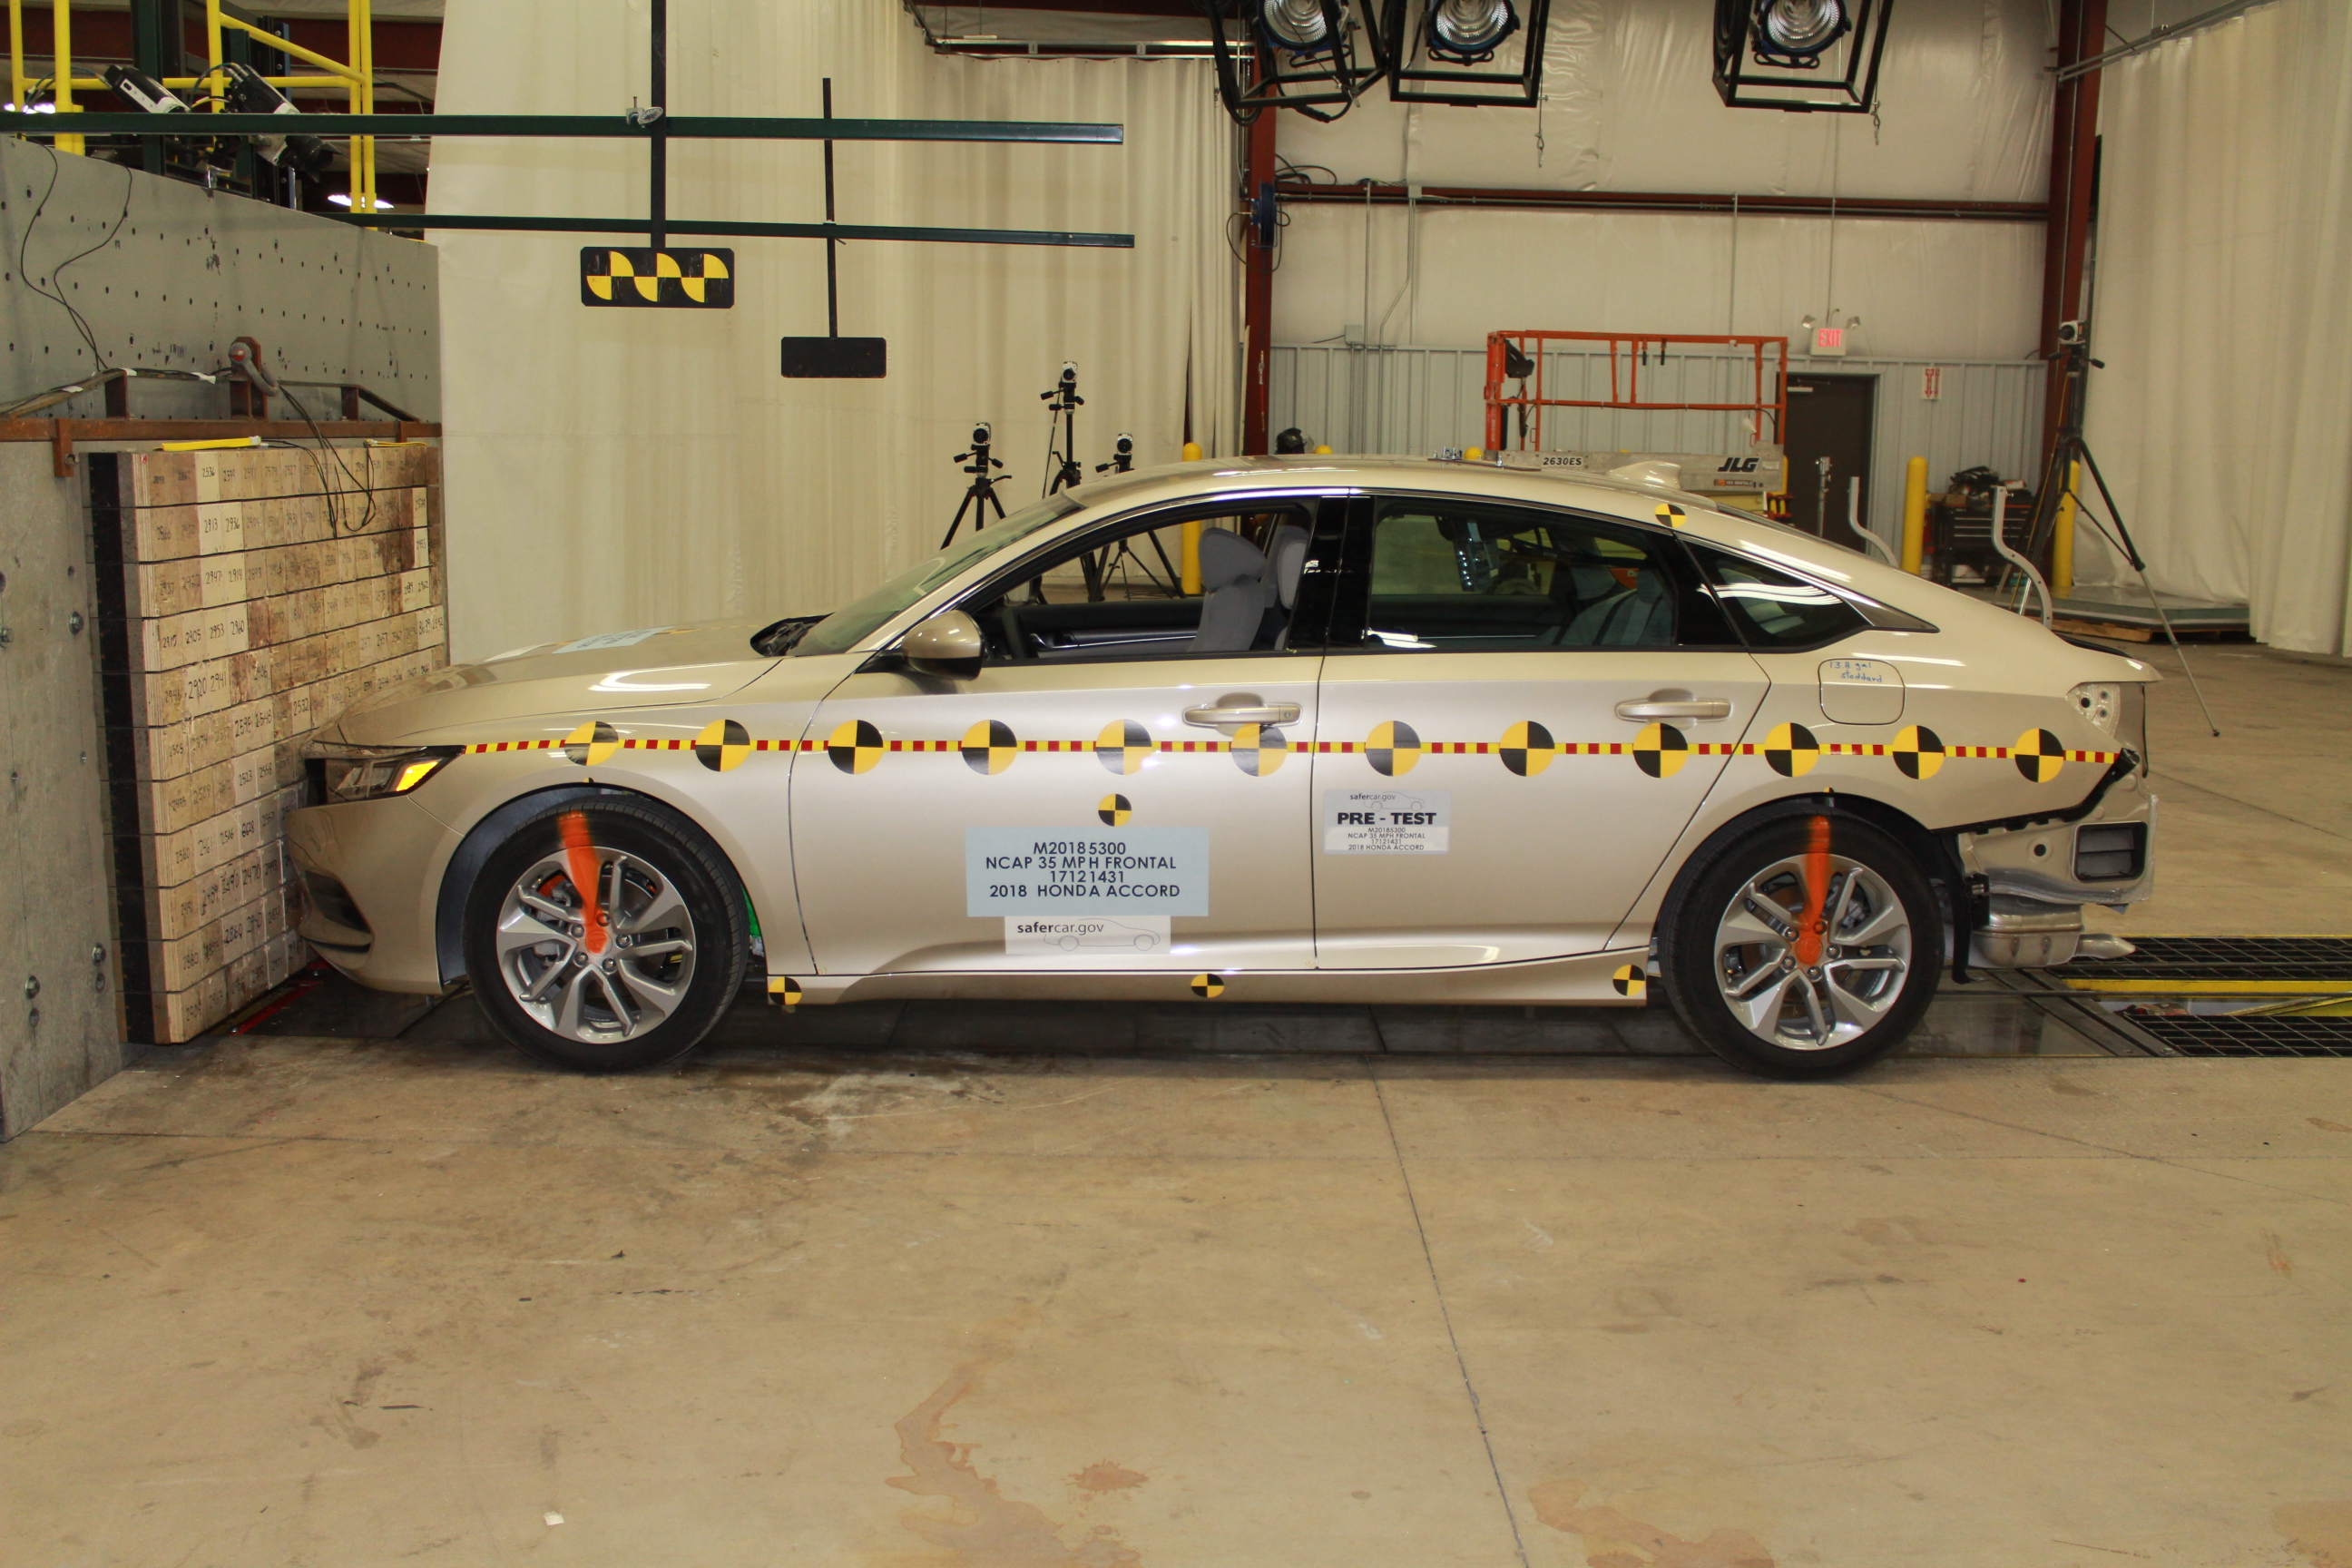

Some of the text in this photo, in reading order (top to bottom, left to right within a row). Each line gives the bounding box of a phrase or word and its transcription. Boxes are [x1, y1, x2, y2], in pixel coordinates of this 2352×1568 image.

[1818, 328, 1843, 347] EXIT
[1543, 456, 1583, 466] 2630ES
[1717, 456, 1760, 473] JLG
[202, 466, 215, 477] 2536
[204, 518, 219, 534] 2913
[226, 516, 240, 533] 2936
[205, 570, 222, 584] 2947
[209, 622, 225, 640] 2953
[230, 620, 245, 635] 2960
[185, 629, 201, 644] 2905
[1855, 662, 1871, 671] gal
[210, 671, 227, 692] 2941
[1839, 670, 1883, 683] stoddard
[293, 697, 309, 716] 2532
[238, 769, 253, 787] 2523
[1349, 793, 1396, 801] safercar.gov
[1337, 812, 1376, 825] PRE
[1390, 812, 1437, 825] TEST
[220, 827, 235, 845] 2516
[985, 857, 1177, 869] NCAP 35 MPH FRONTAL
[242, 863, 261, 886] 2470
[1050, 870, 1124, 884] 17121431
[989, 885, 1181, 897] 2018 HONDA ACCORD
[1017, 921, 1104, 936] safercar.gov
